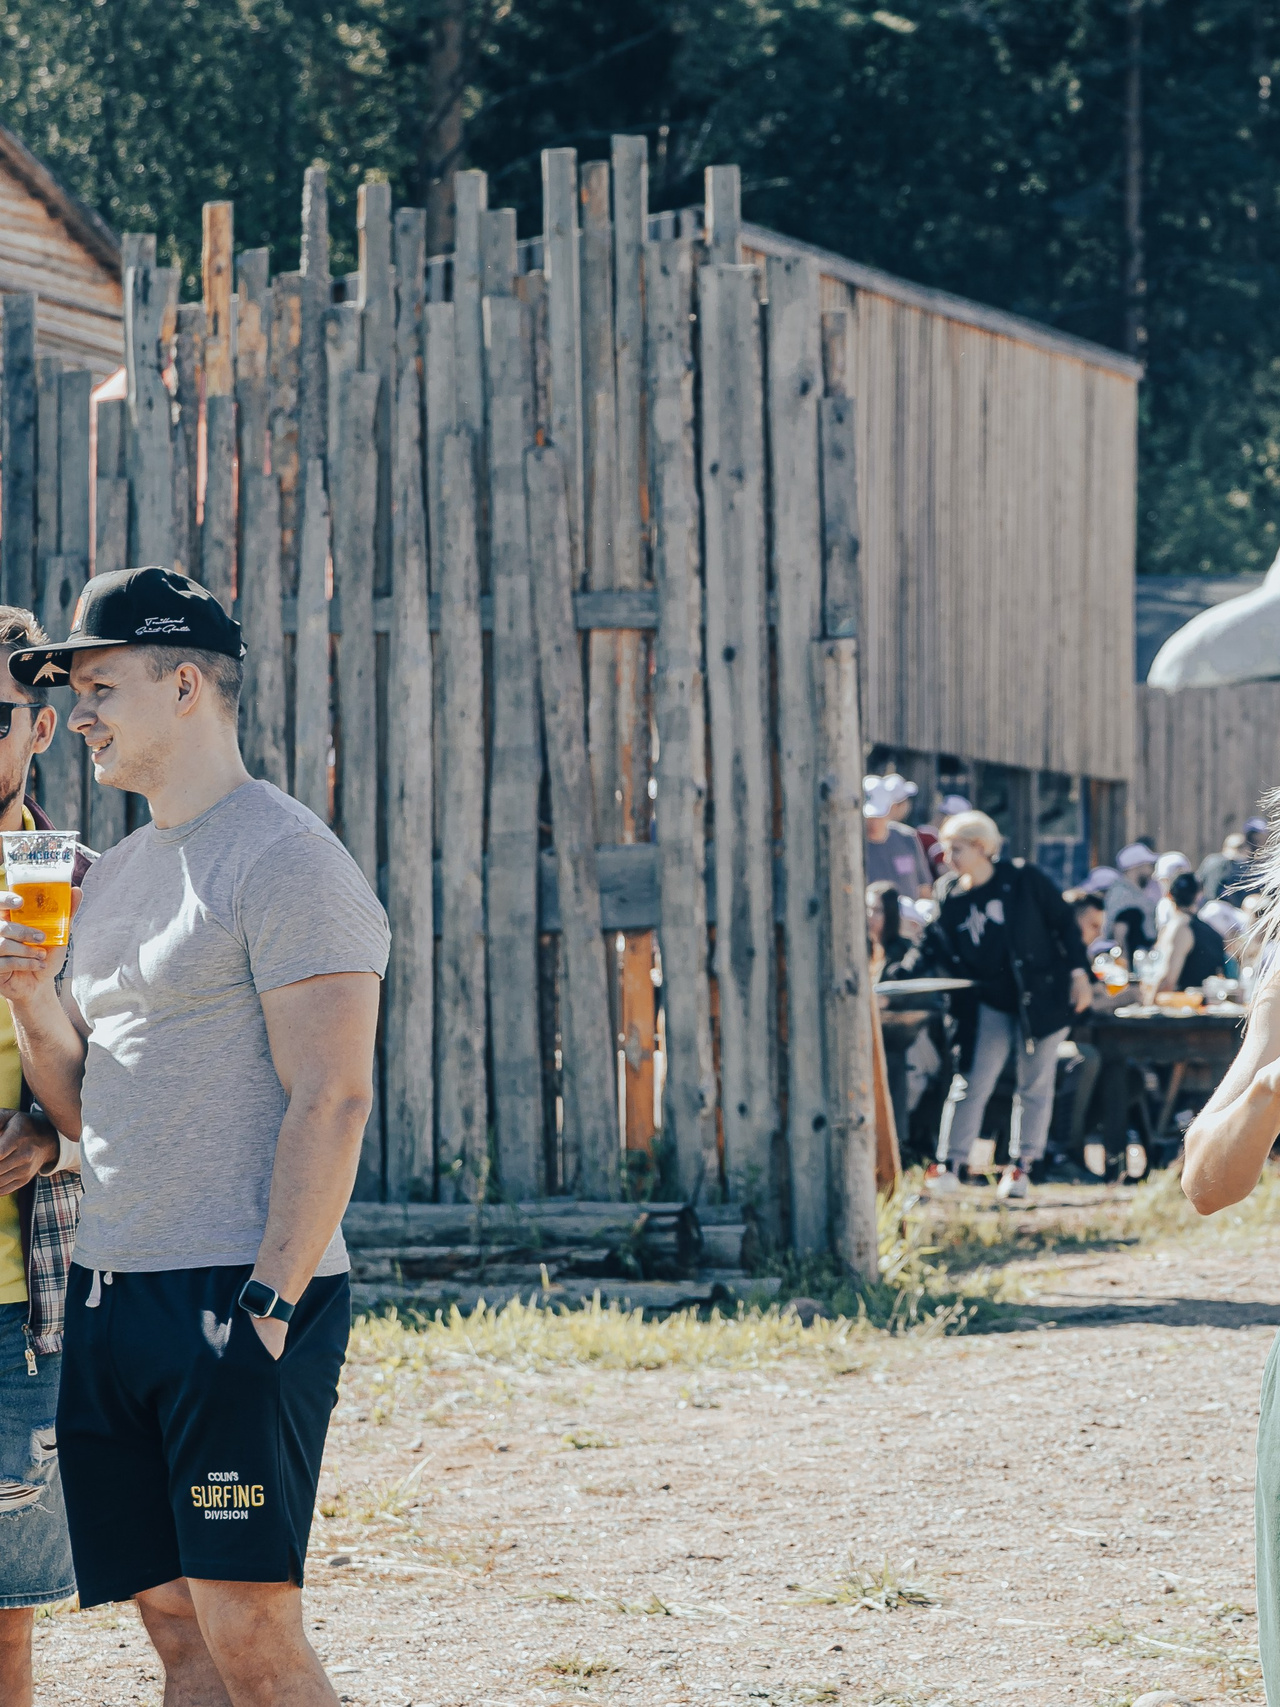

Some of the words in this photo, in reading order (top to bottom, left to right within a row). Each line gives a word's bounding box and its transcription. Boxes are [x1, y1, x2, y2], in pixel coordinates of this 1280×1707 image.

[207, 1471, 239, 1482] COLIN'S
[191, 1484, 265, 1508] SURFING
[204, 1510, 249, 1520] DIVISION
